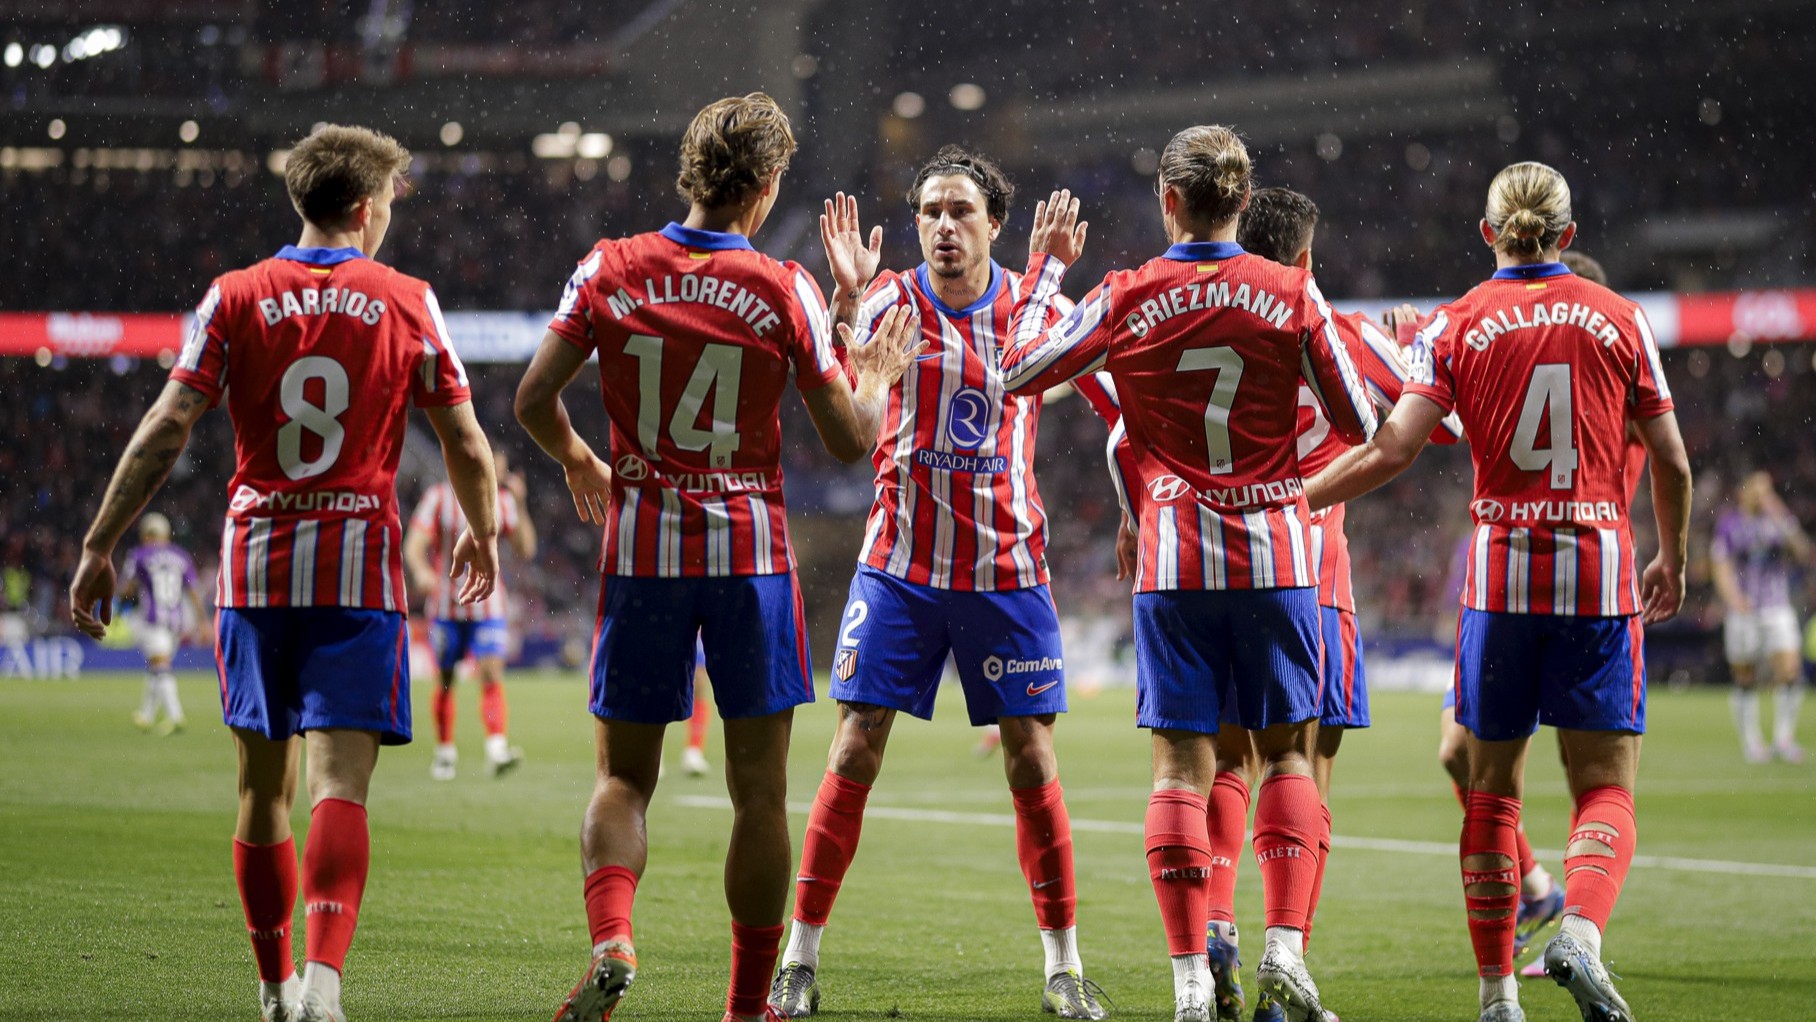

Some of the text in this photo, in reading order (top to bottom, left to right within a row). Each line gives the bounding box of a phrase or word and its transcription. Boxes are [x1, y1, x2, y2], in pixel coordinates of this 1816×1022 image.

[258, 287, 387, 327] BARRIOS
[606, 274, 781, 338] M. LLORENTE
[1126, 281, 1294, 338] GRIEZMANN
[1465, 302, 1620, 352] GALLAGHER
[277, 355, 349, 481] 8
[622, 333, 743, 469] 14
[1175, 345, 1244, 475] 7
[1509, 363, 1578, 490] 4
[654, 470, 768, 494] YUNDAI
[919, 449, 1004, 472] RIYADH AIR
[257, 490, 380, 513] HYUNDAI
[1510, 501, 1619, 521] HYUNDAI
[841, 600, 868, 647] 2
[1006, 656, 1063, 674] ComAve
[1161, 866, 1211, 880] ATLETI
